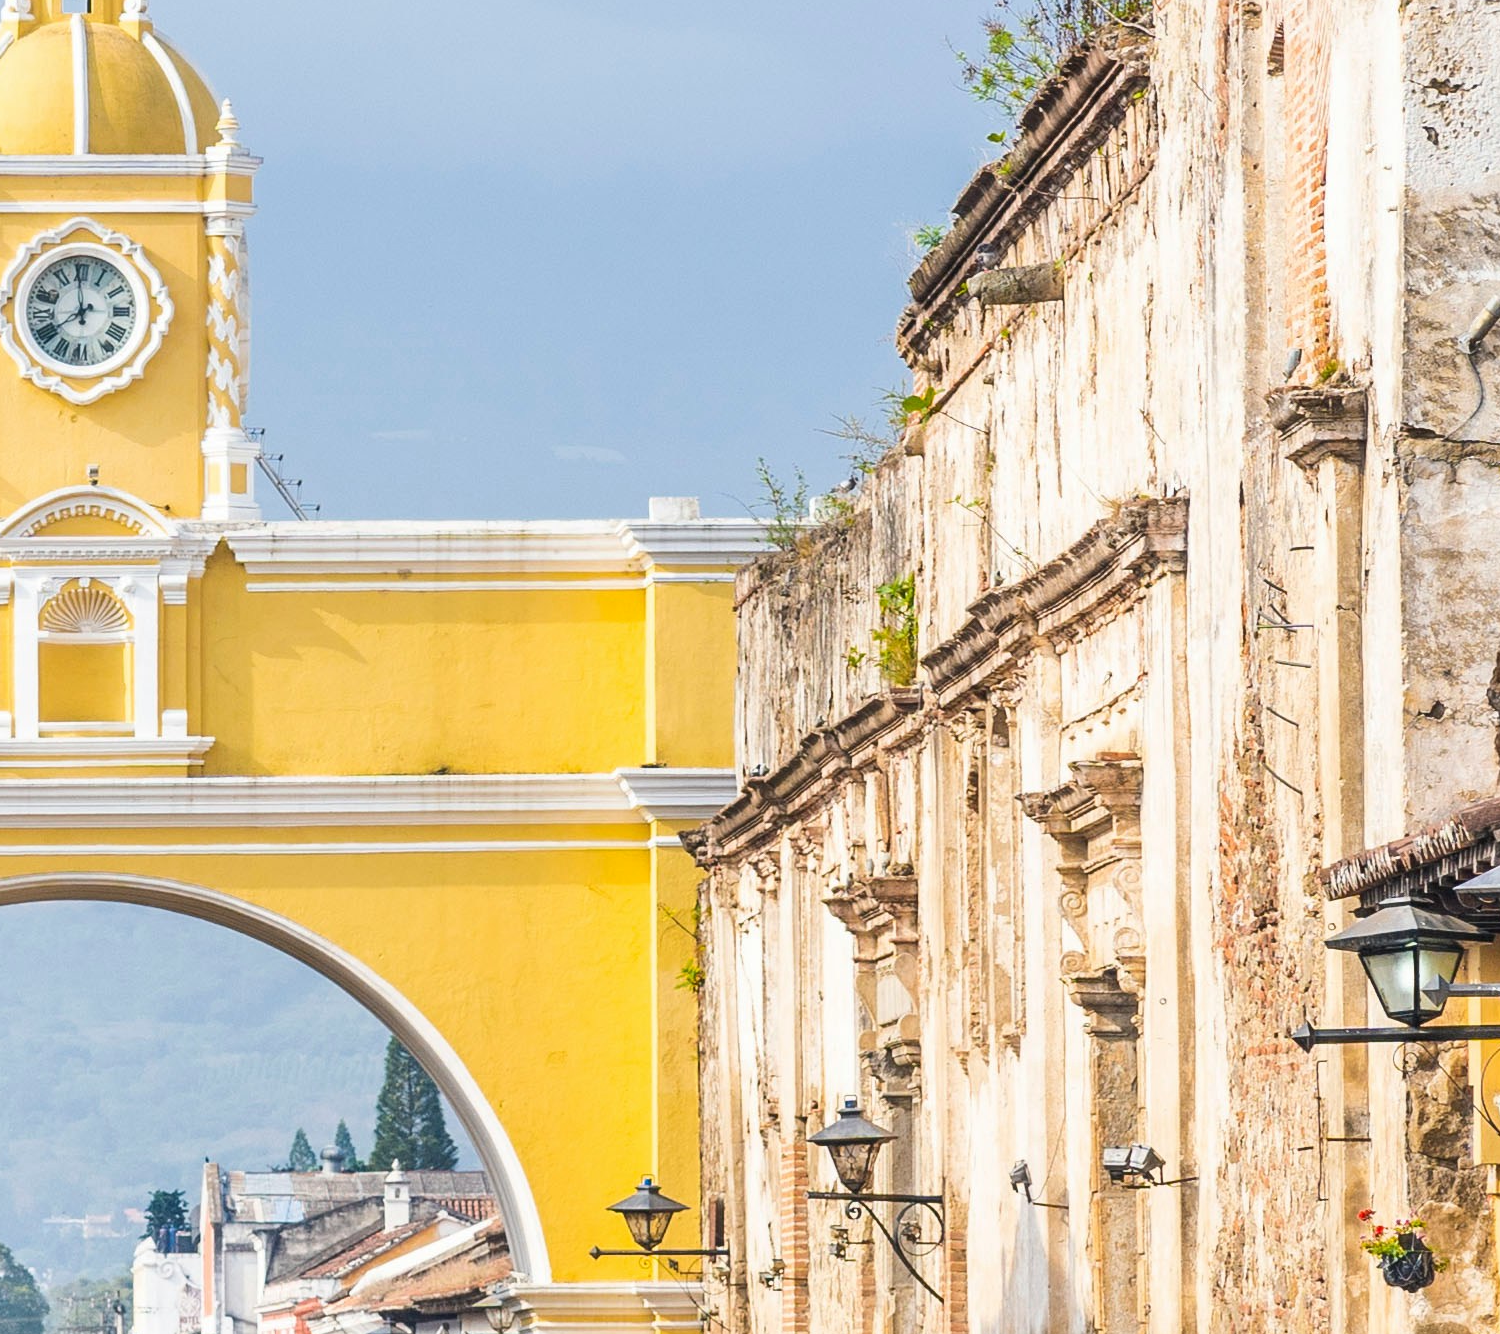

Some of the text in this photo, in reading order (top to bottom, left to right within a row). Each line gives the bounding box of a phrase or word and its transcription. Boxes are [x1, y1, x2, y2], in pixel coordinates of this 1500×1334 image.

[94, 269, 107, 287] I
[107, 286, 125, 299] II
[113, 307, 130, 317] III
[105, 322, 127, 342] IIII
[180, 1316, 200, 1324] HOTEL
